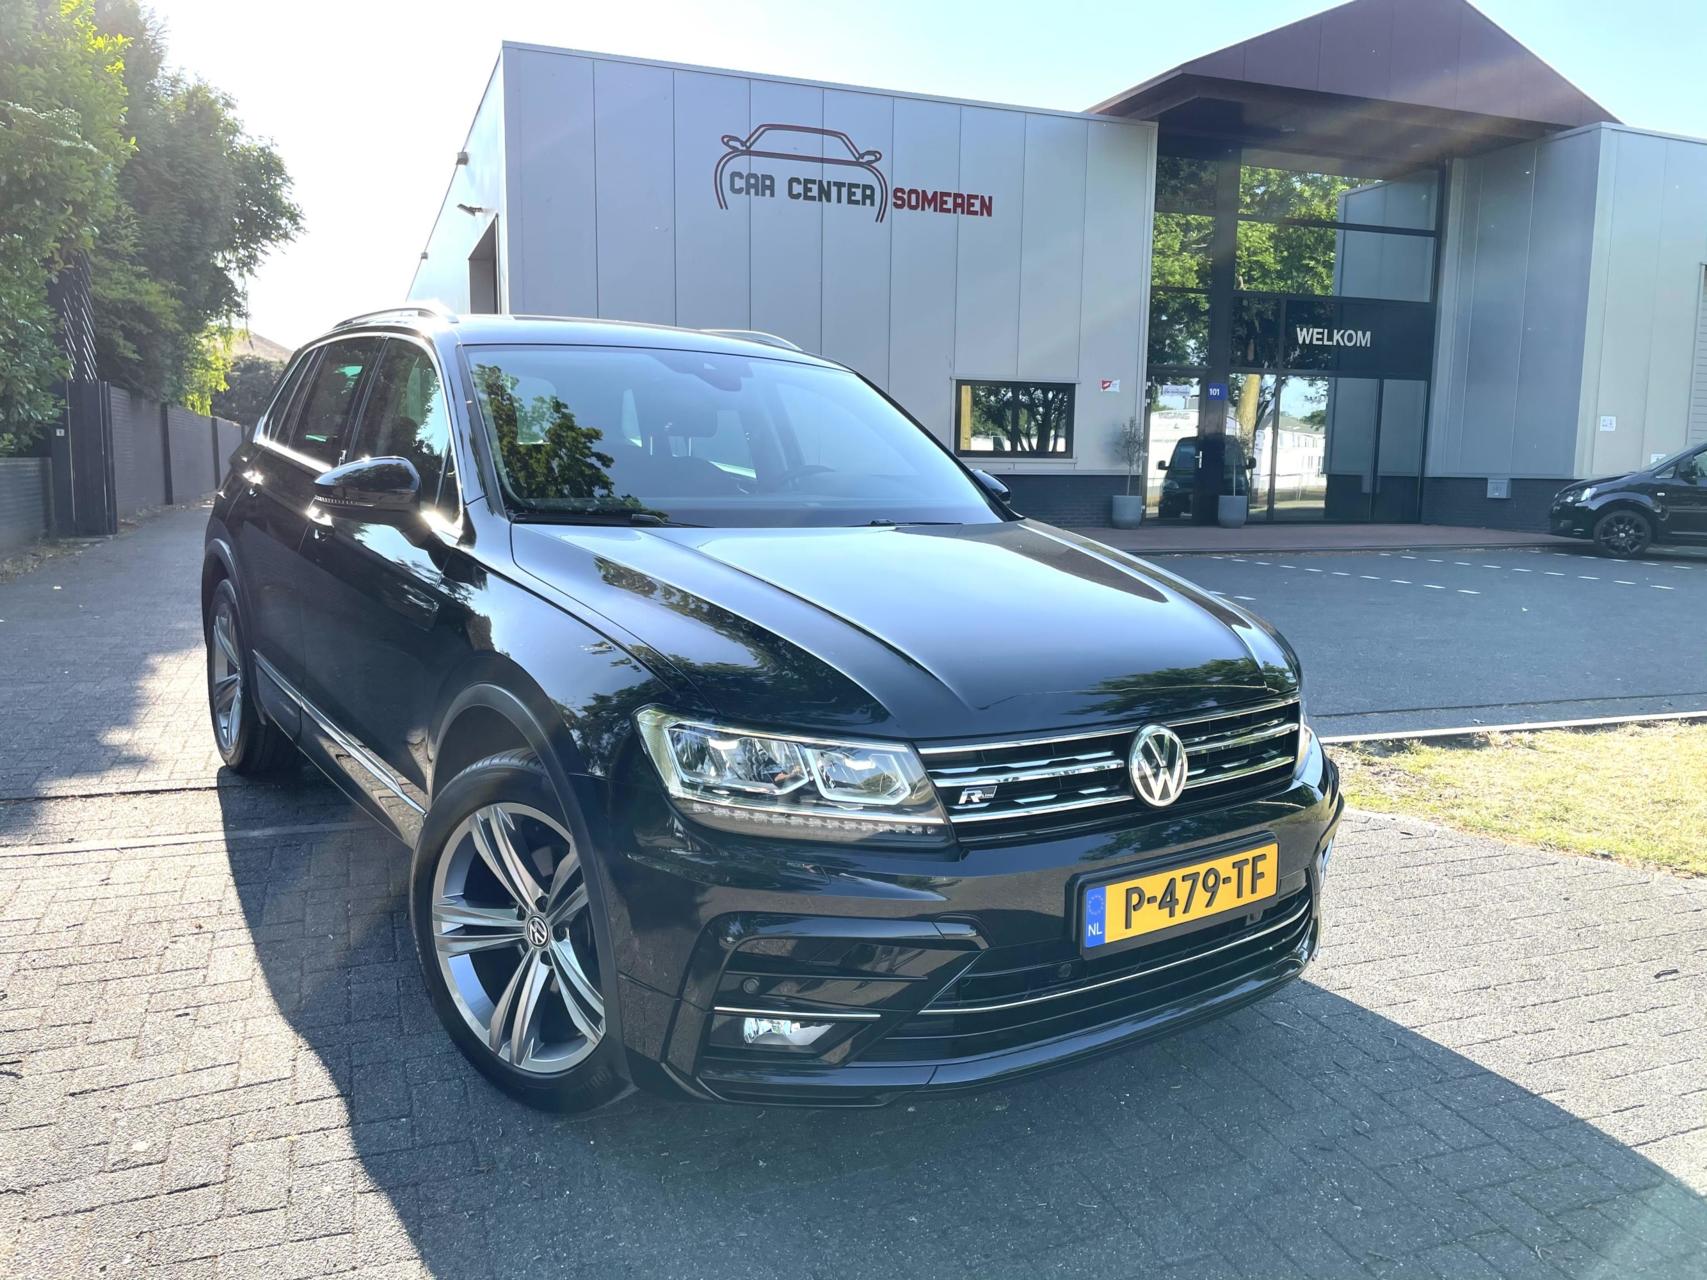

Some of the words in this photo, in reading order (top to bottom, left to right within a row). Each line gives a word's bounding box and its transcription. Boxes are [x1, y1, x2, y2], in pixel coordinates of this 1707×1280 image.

[729, 171, 775, 198] CAR
[787, 176, 876, 207] CENTER
[892, 187, 993, 218] SOMEREN
[1296, 327, 1371, 347] WELKOM
[1209, 388, 1220, 396] 101
[1124, 853, 1267, 929] P-479-TF
[1087, 922, 1103, 937] NL
